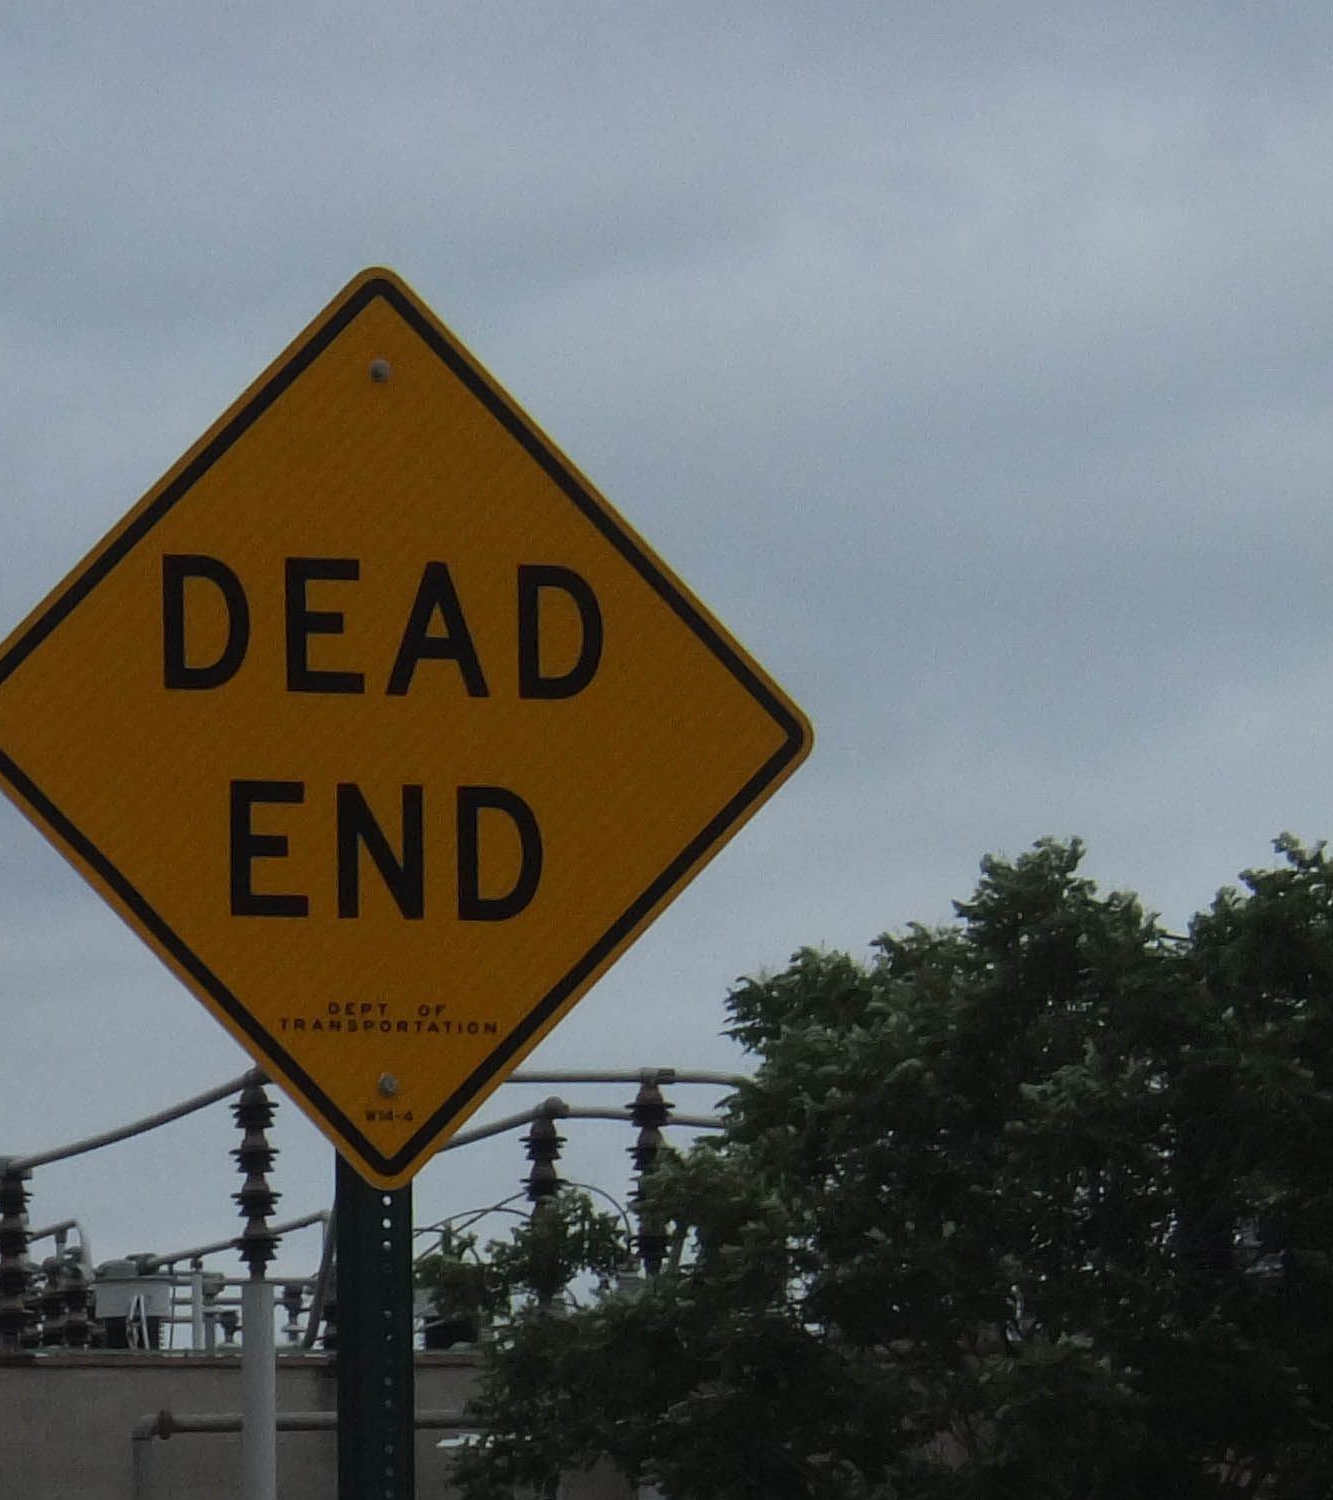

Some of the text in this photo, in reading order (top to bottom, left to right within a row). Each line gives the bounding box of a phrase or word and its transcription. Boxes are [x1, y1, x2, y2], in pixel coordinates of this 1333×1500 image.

[161, 553, 605, 701] DEAD
[229, 779, 544, 923] END
[280, 1018, 499, 1034] TRANSPORTATION
[417, 1004, 447, 1017] OF
